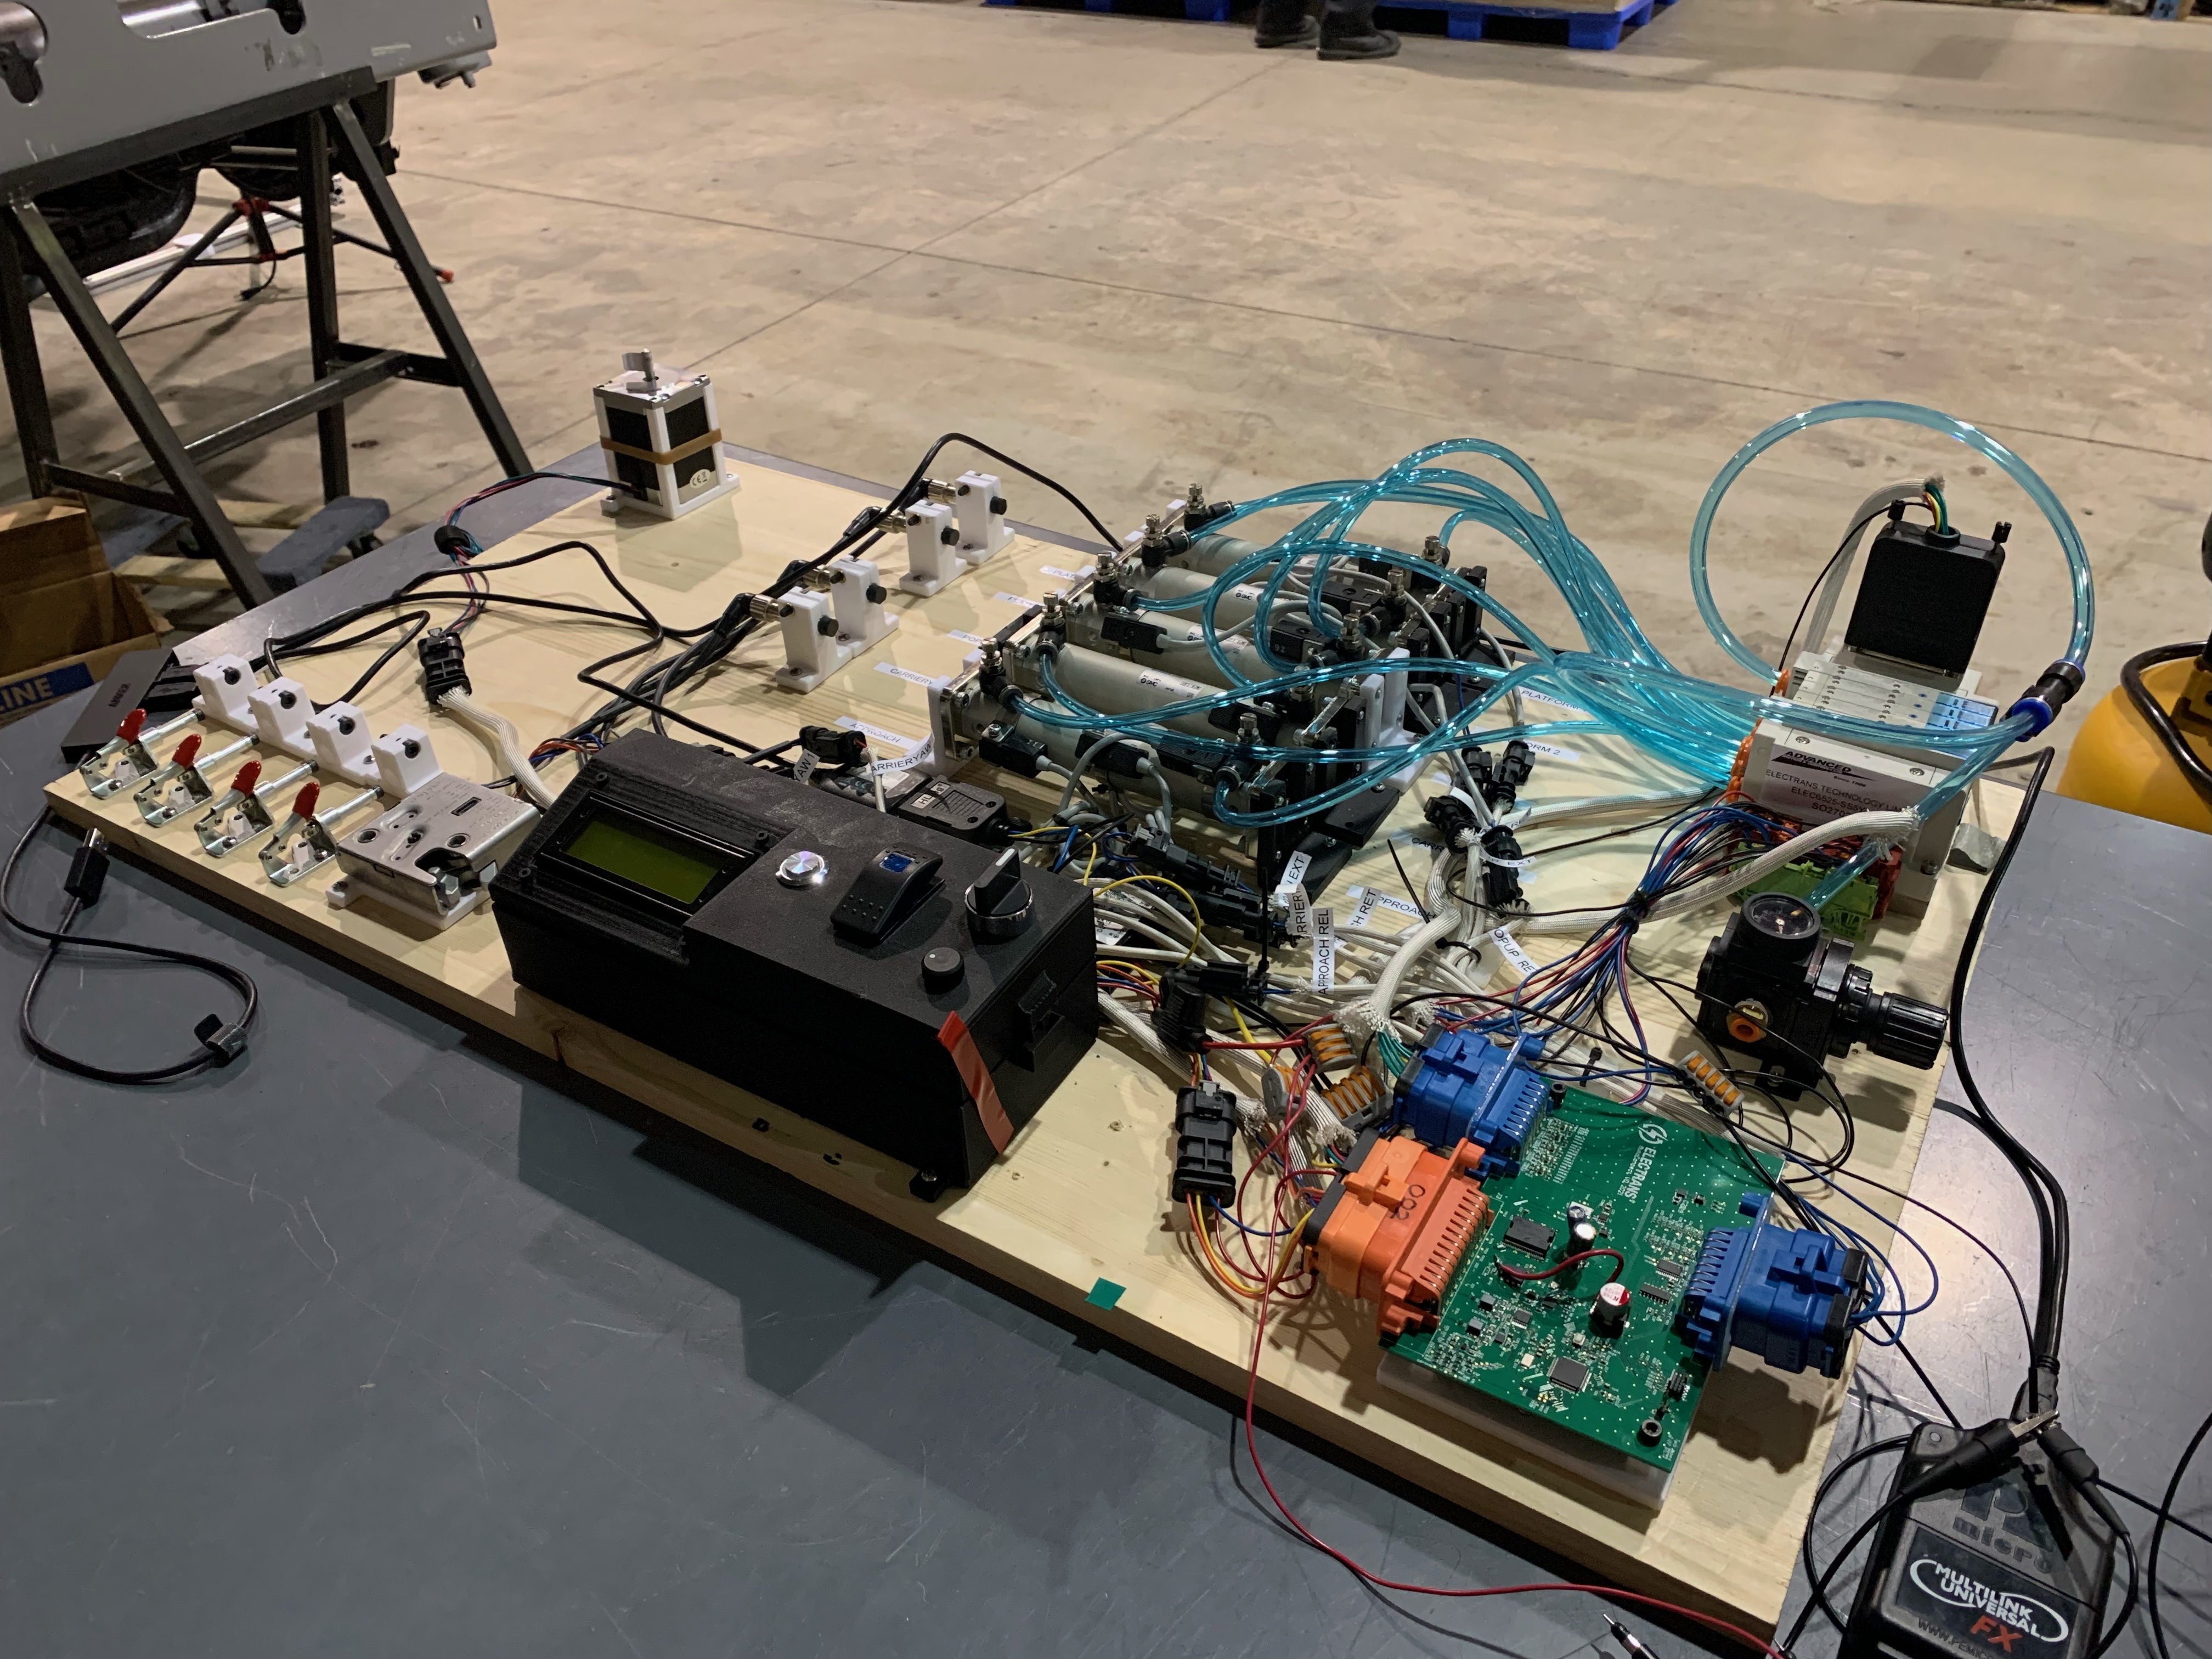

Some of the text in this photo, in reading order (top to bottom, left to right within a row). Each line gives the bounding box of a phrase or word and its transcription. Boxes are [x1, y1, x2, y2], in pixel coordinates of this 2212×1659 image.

[0, 677, 53, 712] INE
[850, 723, 901, 743] APPROACH
[1785, 751, 1852, 772] ADVANCED
[1765, 769, 1819, 790] ELECTRANS
[1821, 785, 1883, 809] TECHNOLOGY
[1289, 855, 1305, 881] EXT
[1359, 888, 1378, 916] RET
[1318, 909, 1330, 995] APPROACH REL
[1624, 1147, 1657, 1200] ELECTRANS
[1390, 1184, 1426, 1221] 002
[1935, 1563, 2034, 1622] MULTILINK
[1940, 1577, 2042, 1638] UNIVERSAL
[1970, 1615, 2023, 1653] FX
